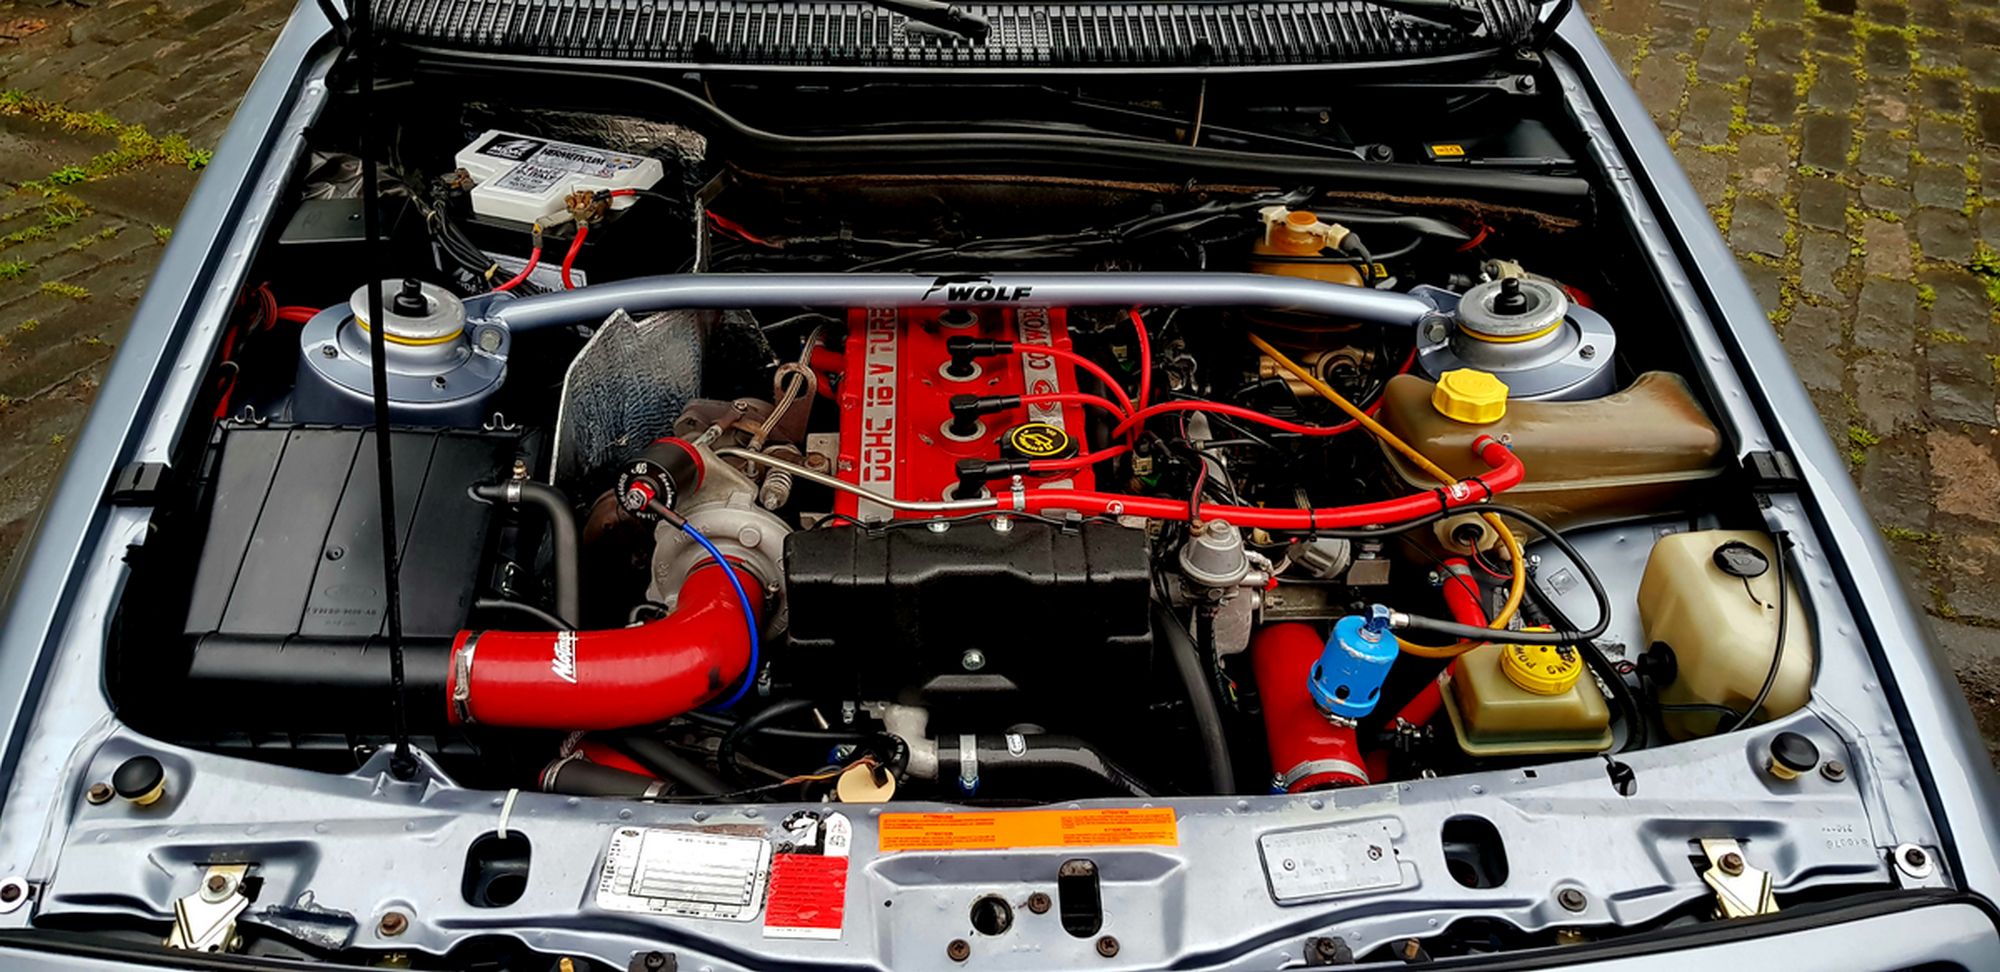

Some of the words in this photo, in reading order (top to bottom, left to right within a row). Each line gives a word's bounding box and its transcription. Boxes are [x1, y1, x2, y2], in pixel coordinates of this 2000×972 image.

[948, 286, 1032, 301] WOLF
[868, 305, 898, 354] TURB
[1021, 305, 1052, 370] COWOR
[863, 418, 893, 482] DOHC
